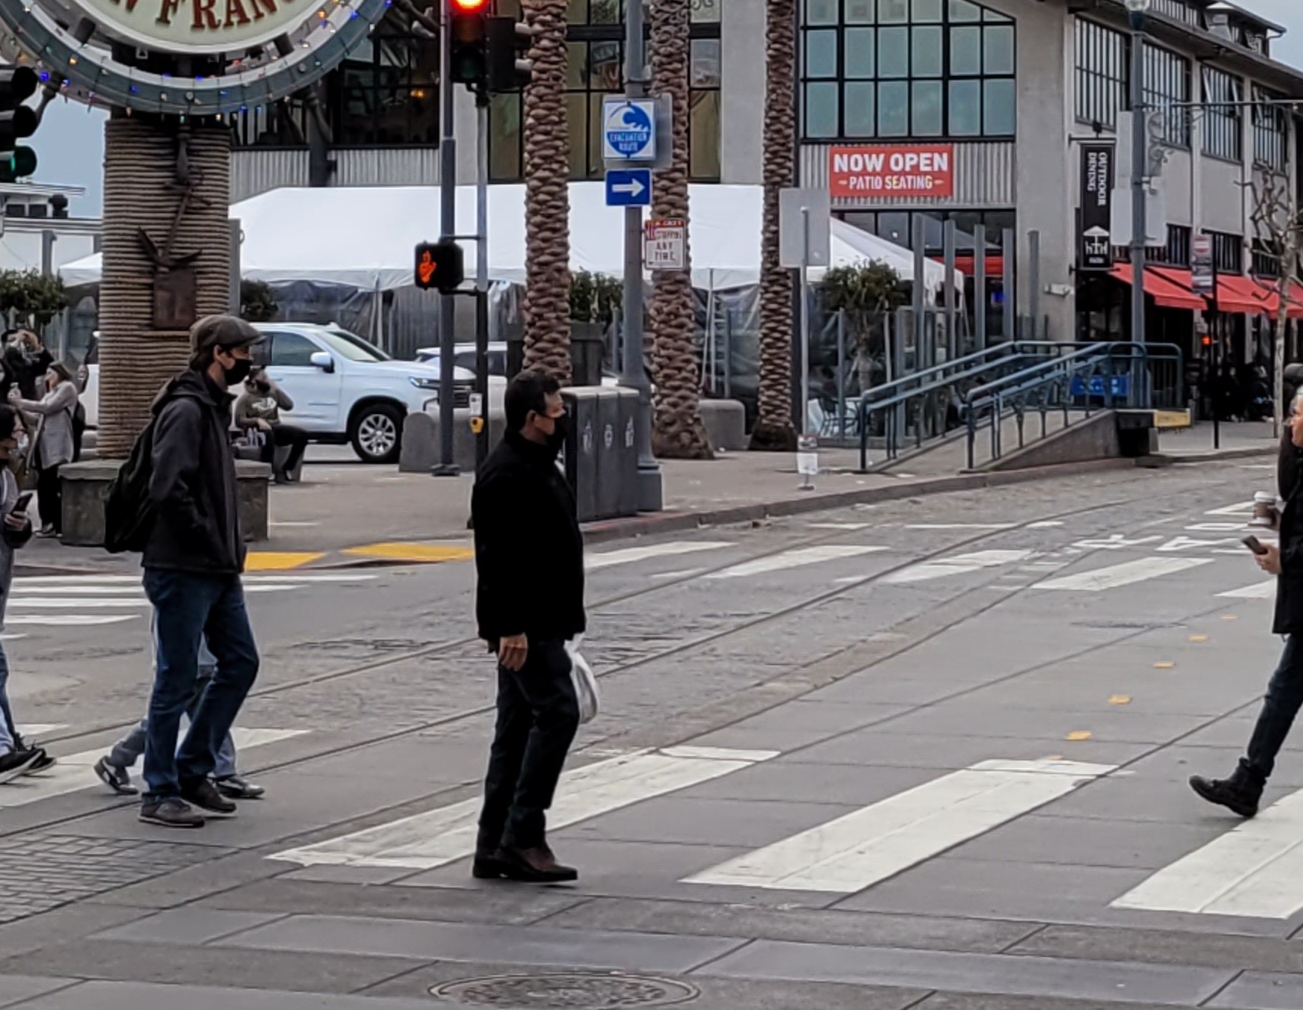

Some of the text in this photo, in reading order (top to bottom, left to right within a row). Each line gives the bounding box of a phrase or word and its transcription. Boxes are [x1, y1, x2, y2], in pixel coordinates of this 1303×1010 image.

[834, 152, 948, 172] NOW OPEN
[1087, 152, 1098, 191] DINING
[849, 175, 933, 190] PATIO SEATING
[1098, 152, 1108, 207] OUTDOOR
